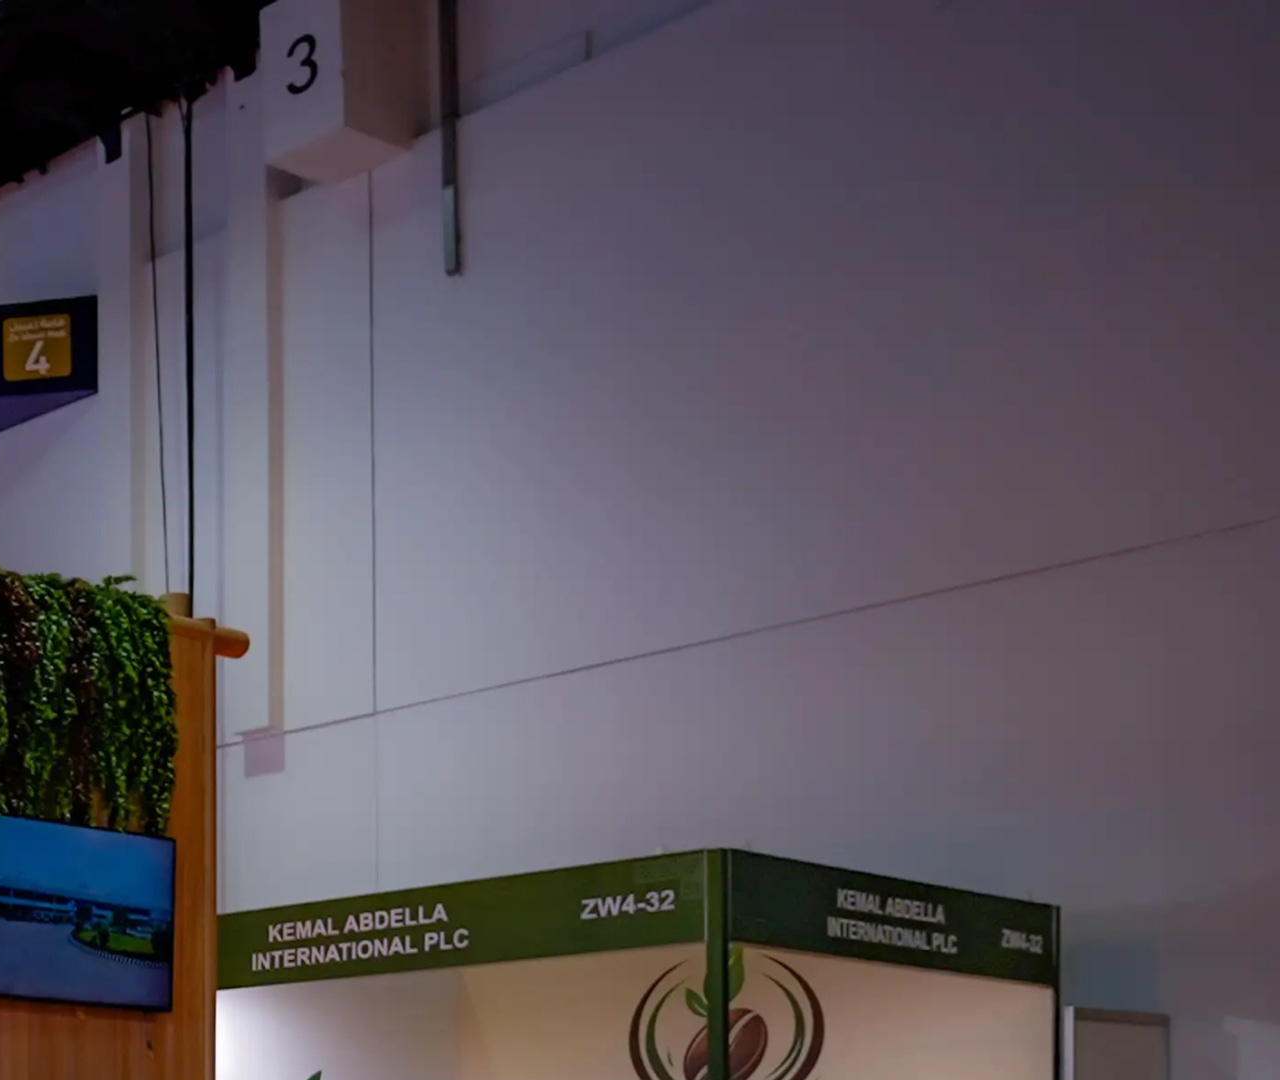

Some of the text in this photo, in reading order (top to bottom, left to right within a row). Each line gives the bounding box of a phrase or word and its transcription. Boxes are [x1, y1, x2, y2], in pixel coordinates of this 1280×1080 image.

[286, 34, 318, 94] 3
[25, 340, 50, 375] 4
[268, 903, 448, 942] KEMAL ABDELLA
[580, 890, 675, 921] ZW4-32
[837, 888, 946, 925] KEMAL ABDELLA
[251, 928, 469, 971] INTERNATIONAL PLC
[827, 916, 958, 954] INTERNATIONAL PLC
[1001, 928, 1043, 954] ZW4-32
